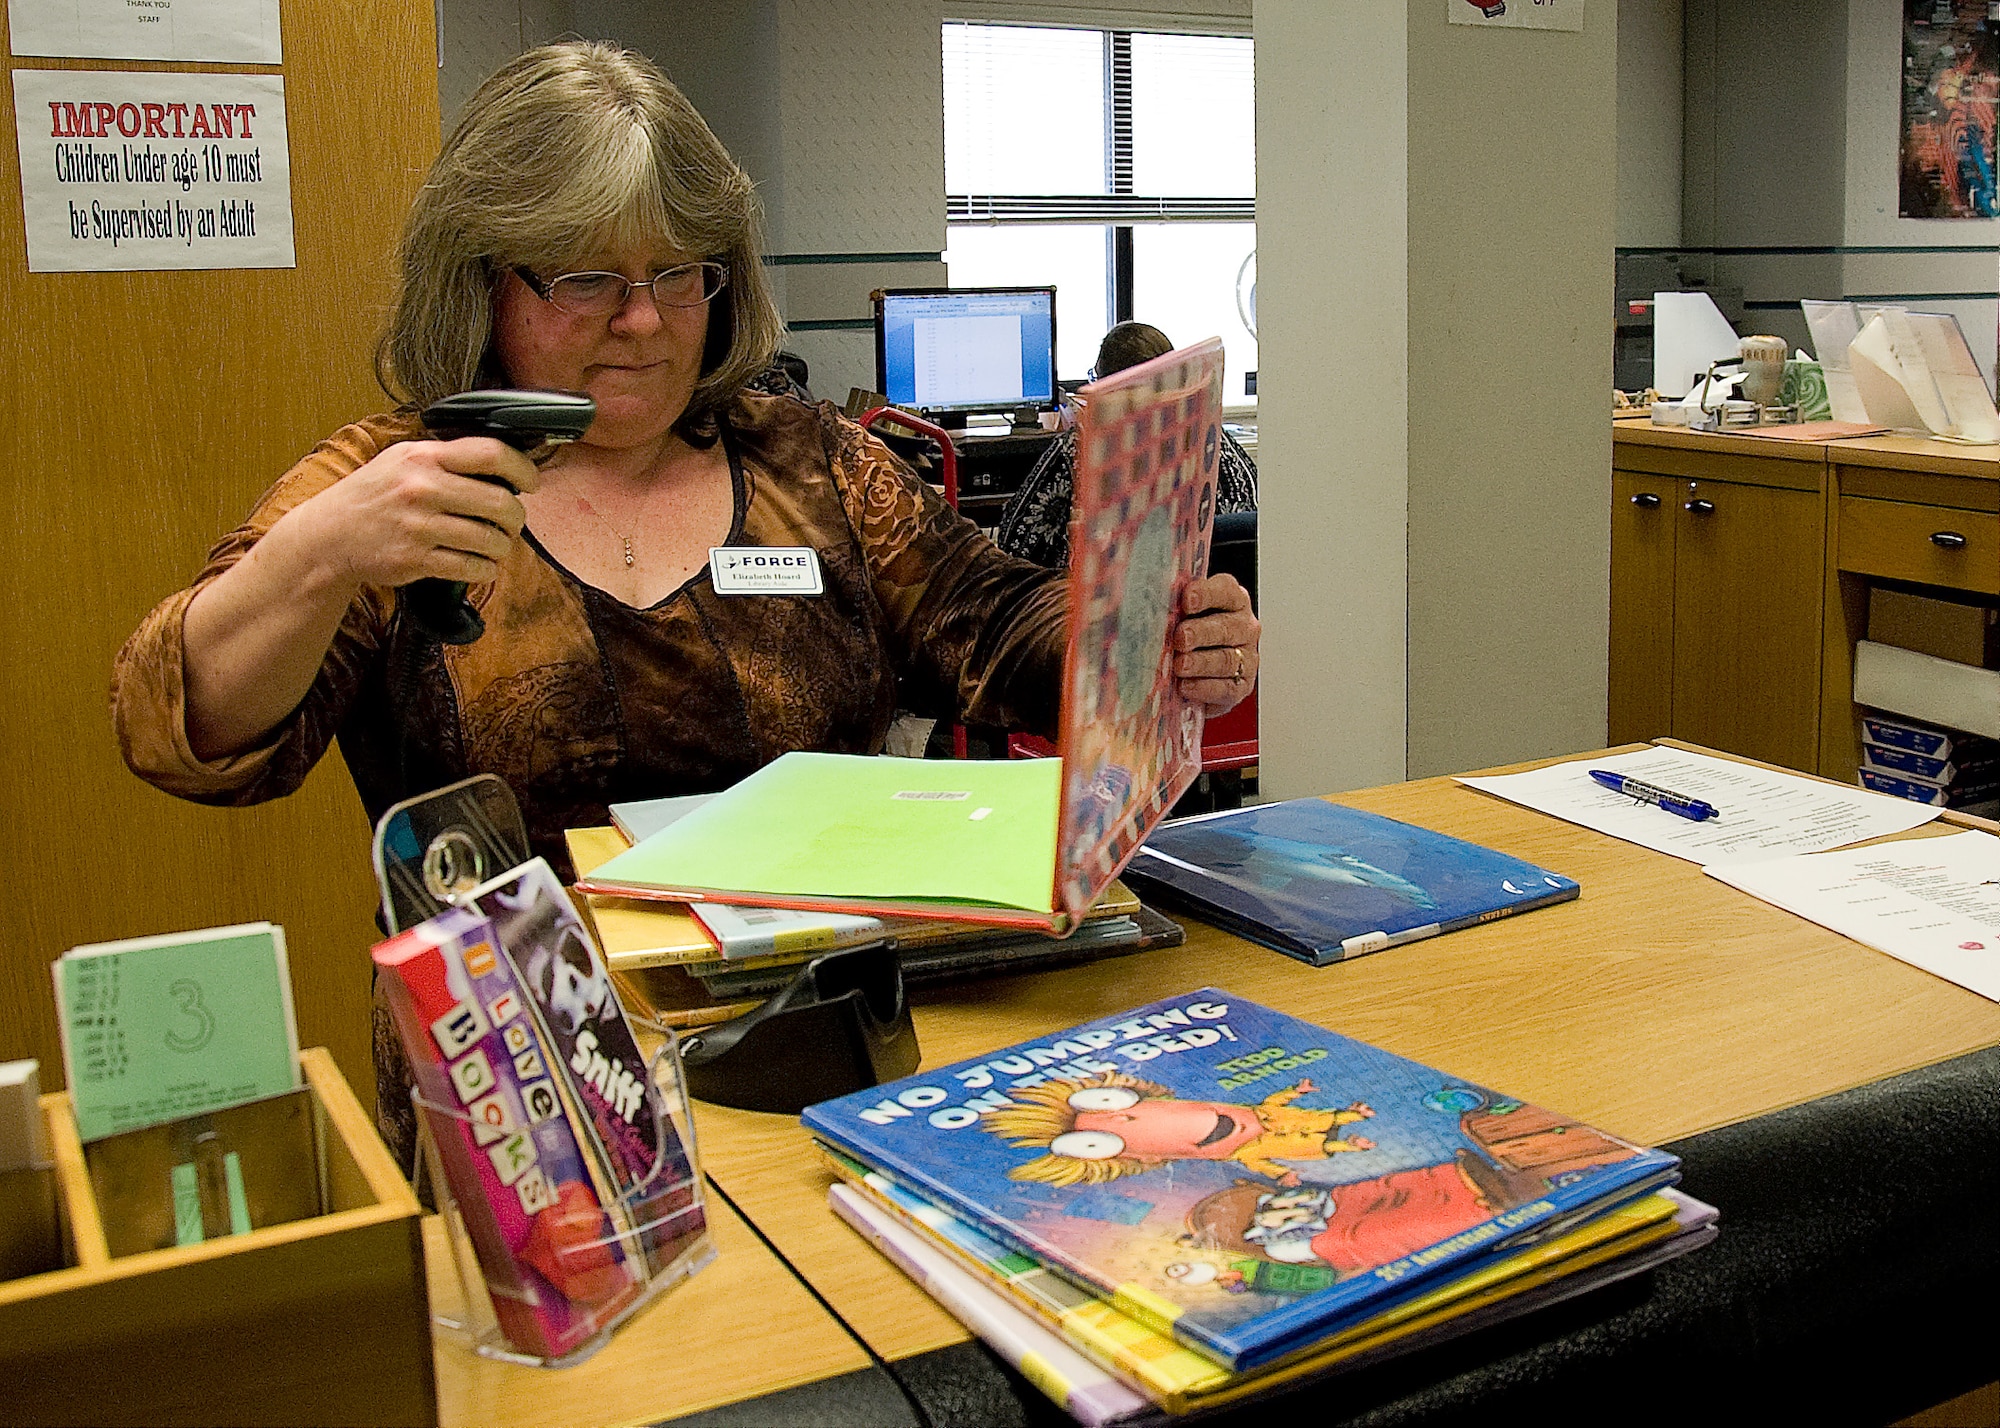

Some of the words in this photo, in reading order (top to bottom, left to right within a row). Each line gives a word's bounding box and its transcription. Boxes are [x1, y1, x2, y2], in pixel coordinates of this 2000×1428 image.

[154, 1, 170, 9] YOU
[48, 101, 257, 139] IMPORTANT
[55, 143, 120, 183] Children
[122, 144, 167, 183] Under
[172, 147, 199, 192] age
[202, 143, 222, 183] 10
[226, 146, 262, 183] must
[69, 199, 89, 240] be
[91, 199, 173, 248] Supervised
[176, 199, 193, 247] by
[197, 207, 216, 238] an
[219, 199, 256, 238] Adult
[743, 556, 807, 567] FORCE
[163, 977, 216, 1054] 3
[570, 1029, 646, 1125] Sniff
[857, 1085, 949, 1126] NO
[953, 1001, 1230, 1089] JUMPING
[926, 1088, 1015, 1130] ON
[1010, 1053, 1120, 1090] THE
[1113, 1023, 1239, 1062] BED!
[1214, 1047, 1286, 1074] TEDD
[1217, 1048, 1329, 1092] ARNOLD
